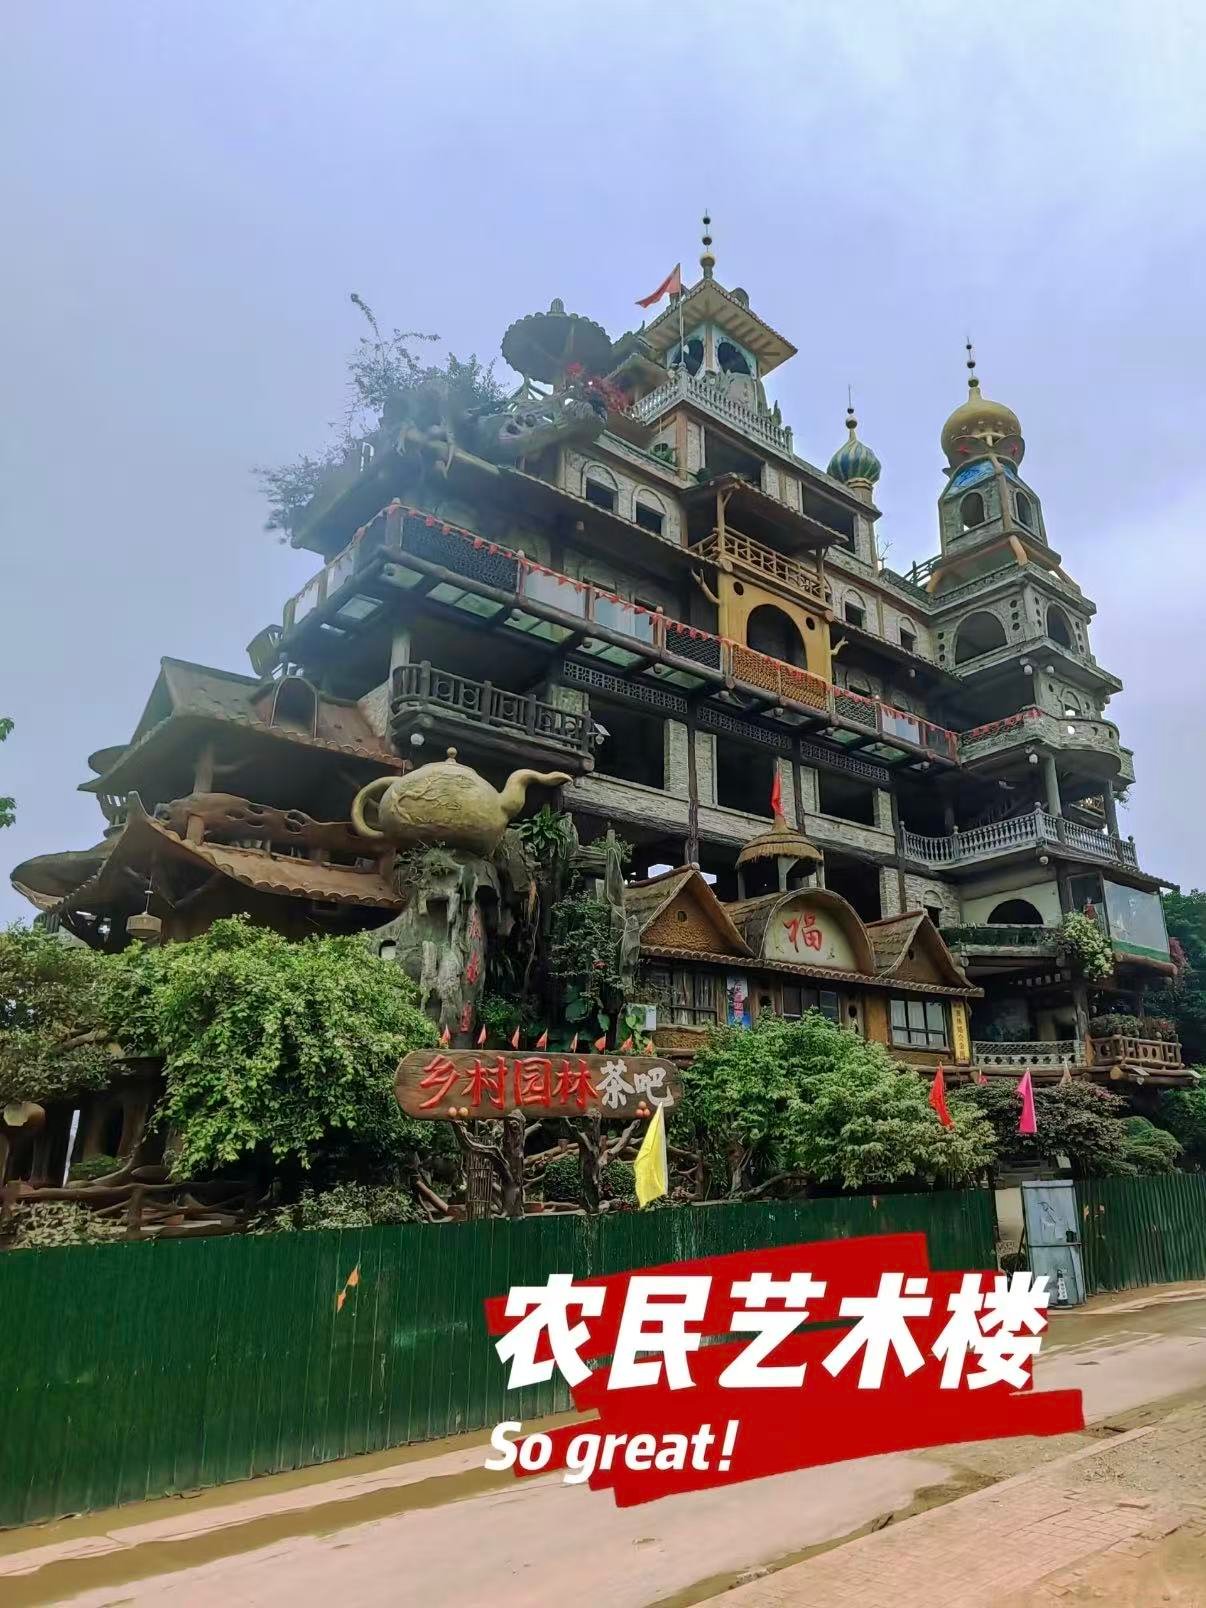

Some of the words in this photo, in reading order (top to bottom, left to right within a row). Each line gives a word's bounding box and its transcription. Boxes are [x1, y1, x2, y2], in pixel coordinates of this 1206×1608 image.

[783, 911, 822, 952] 福
[419, 1054, 675, 1109] 乡村园林茶吧
